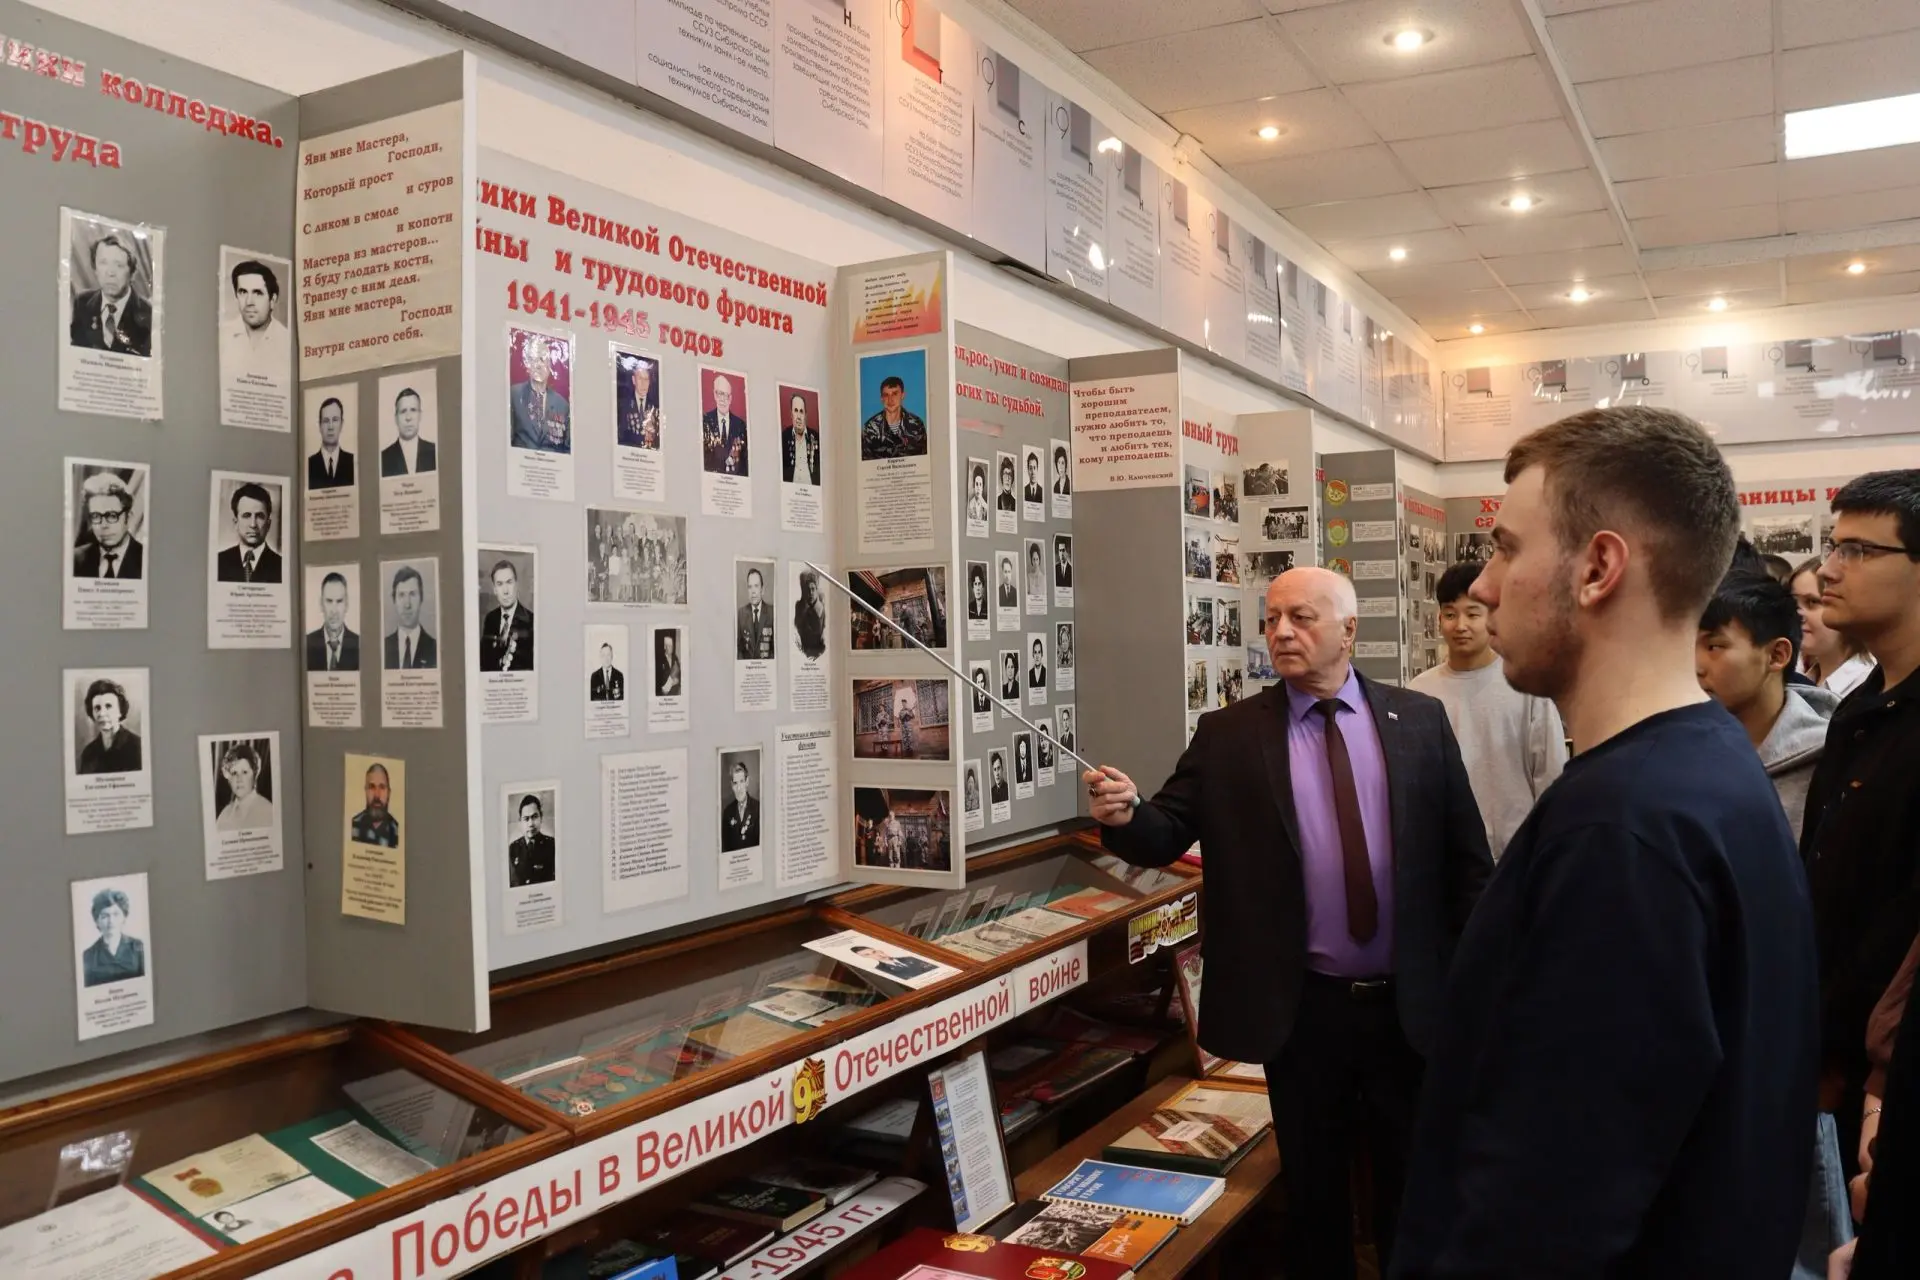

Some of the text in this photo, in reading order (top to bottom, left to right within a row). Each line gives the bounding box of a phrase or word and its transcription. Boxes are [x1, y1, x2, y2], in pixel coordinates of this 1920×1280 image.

[678, 27, 713, 50] техникум
[714, 31, 753, 58] Сибирской
[647, 52, 770, 116] социалистического соревнования
[668, 75, 711, 100] техникумов
[711, 93, 751, 119] Сибирской
[99, 68, 284, 149] колледжа.
[0, 110, 122, 170] труда
[304, 132, 409, 166] Яви мне Мастера,
[387, 142, 443, 163] Господи,
[303, 171, 394, 201] Который прост
[406, 176, 454, 195] и суров
[303, 206, 399, 235] С ликом в смоле
[396, 212, 453, 234] и копоти
[303, 235, 439, 271] Мастера из мастеров...
[476, 177, 537, 219] ики
[547, 195, 660, 257] Великой
[668, 234, 829, 308] Отечественной
[303, 253, 434, 288] Я буду глодать кости,
[303, 272, 421, 307] Трапезу с ним деля.
[554, 248, 573, 275] и
[582, 256, 710, 312] трудового
[716, 288, 794, 335] фронта
[303, 295, 406, 322] Яви мне мастера,
[400, 304, 453, 322] Господи
[507, 279, 724, 359] 1941-1945 годов
[304, 326, 423, 358] Внутри самого себя.
[1020, 367, 1027, 381] и
[985, 389, 999, 406] ты
[1001, 395, 1045, 418] судьбой.
[1073, 386, 1135, 398] Чтобы быть
[1081, 398, 1127, 409] хорошим
[1075, 418, 1166, 433] нужно любить то,
[1085, 406, 1171, 421] преподавателем,
[1101, 441, 1173, 453] и любить тех,
[1109, 429, 1172, 442] преподаешь
[1182, 418, 1239, 457] вный труд
[1079, 450, 1173, 465] кому преподаешь.
[1128, 471, 1174, 481] Ключевский
[793, 1076, 812, 1124] 9
[391, 957, 1082, 1280] Победы в Великой Отечественной войне
[838, 1203, 884, 1225] гг.
